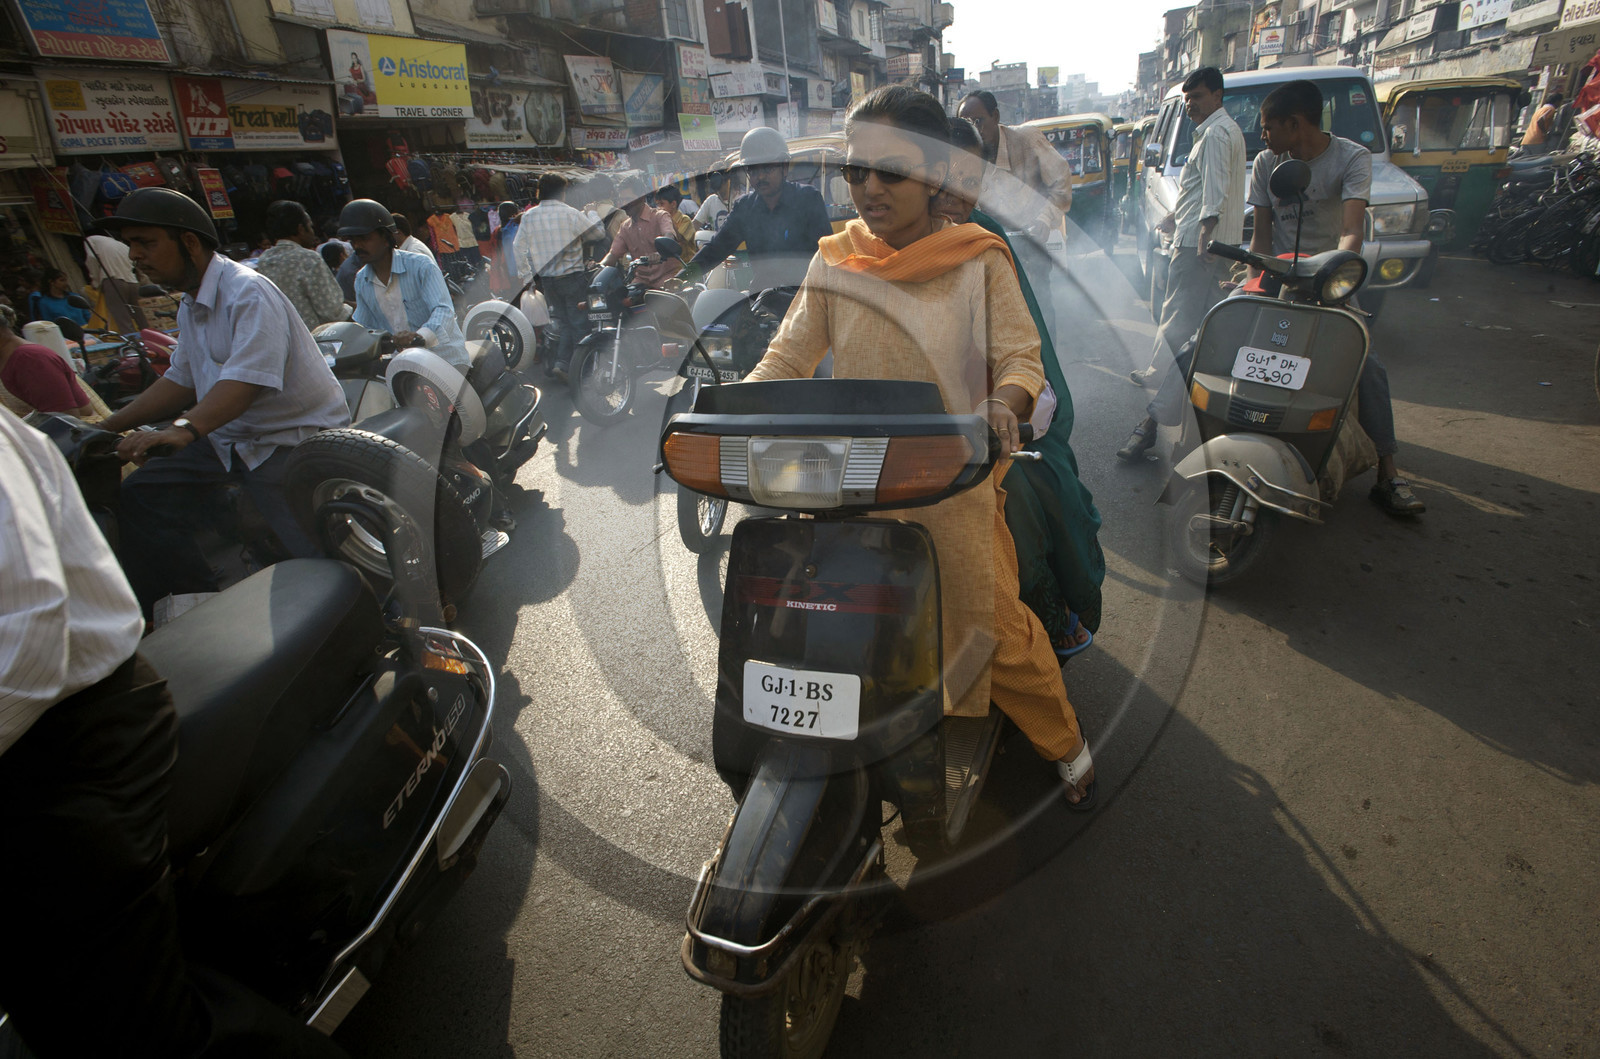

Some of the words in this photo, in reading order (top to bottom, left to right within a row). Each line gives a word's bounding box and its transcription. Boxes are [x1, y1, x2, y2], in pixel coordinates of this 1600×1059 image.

[68, 11, 120, 28] GOPAL
[398, 57, 467, 81] Aristocrat
[395, 107, 427, 117] TRAVEL
[430, 107, 464, 117] CORNER
[55, 112, 105, 134] ગોપાલ
[105, 111, 142, 134] પોકેટ
[143, 111, 178, 134] સ્ટોર્સ
[60, 137, 85, 148] GOPAL
[86, 136, 117, 147] POCKET
[118, 135, 147, 146] STORES
[1047, 129, 1077, 142] OVE
[1271, 332, 1289, 346] bajaj
[1244, 409, 1270, 424] super
[786, 600, 837, 612] KINETIC
[770, 704, 819, 729] 7227
[383, 728, 447, 830] ETERNO
[444, 693, 466, 736] 150
